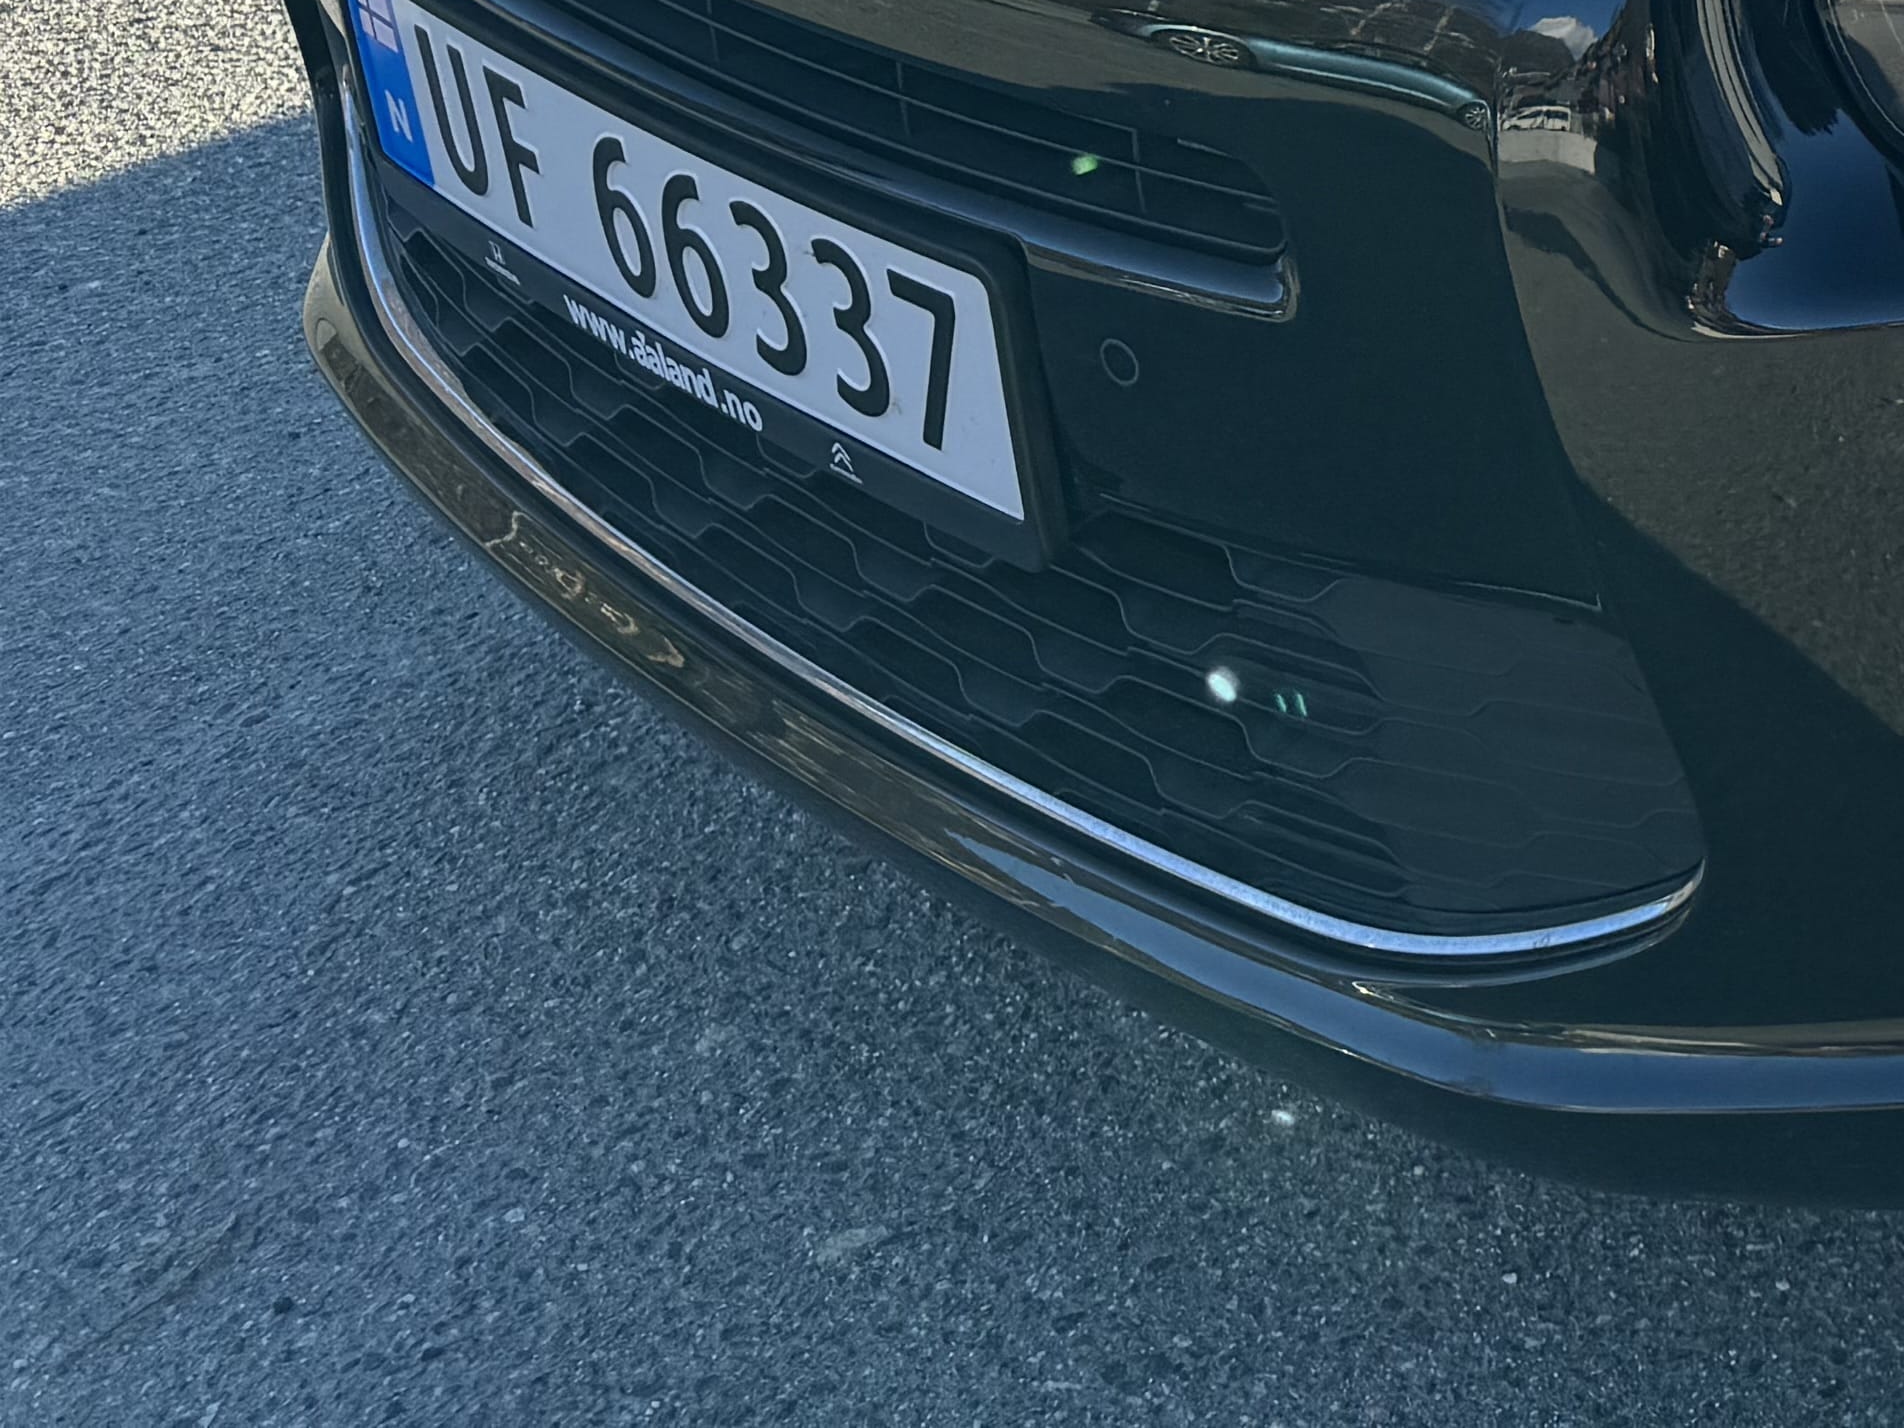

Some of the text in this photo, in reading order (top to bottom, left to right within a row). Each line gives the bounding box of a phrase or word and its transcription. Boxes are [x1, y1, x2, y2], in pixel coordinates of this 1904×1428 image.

[384, 88, 414, 143] N
[413, 22, 957, 452] UF 66337
